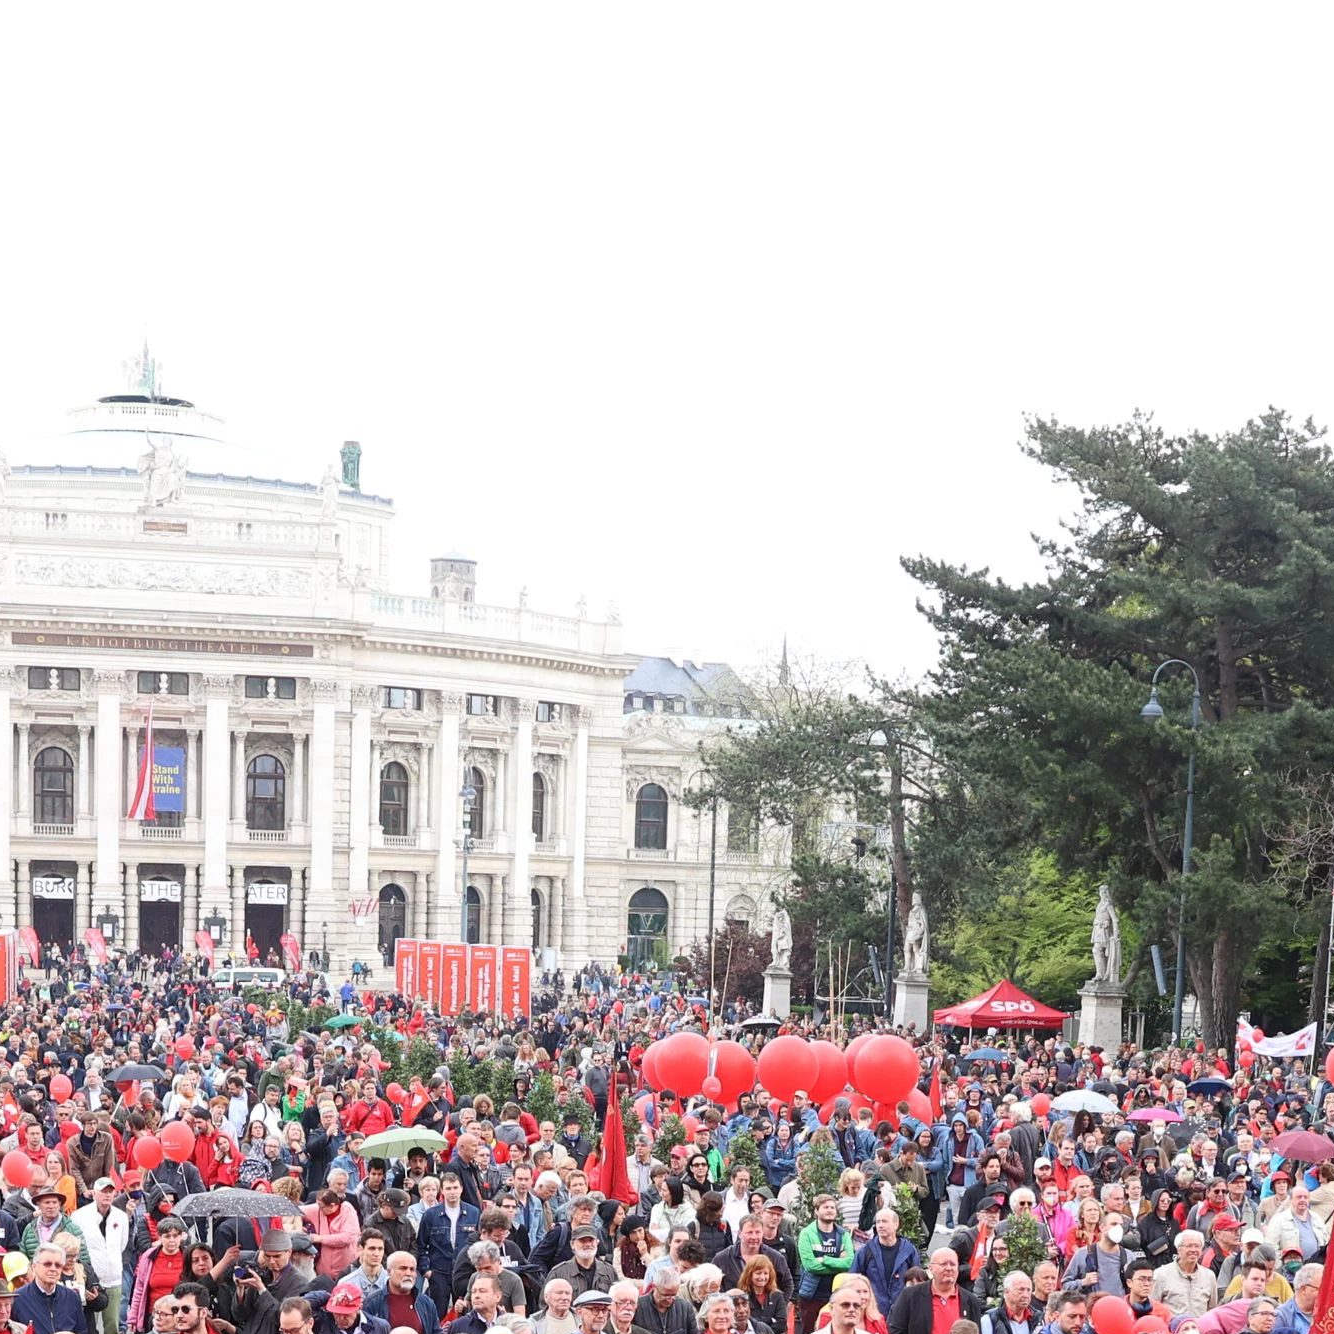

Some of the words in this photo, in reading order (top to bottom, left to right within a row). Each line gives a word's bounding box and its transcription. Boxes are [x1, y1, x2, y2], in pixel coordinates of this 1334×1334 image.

[152, 764, 179, 775] Stand
[152, 784, 180, 794] kraine
[248, 885, 286, 899] ATER
[450, 960, 458, 1012] Freundschaft!
[990, 1000, 1036, 1013] SPÖ
